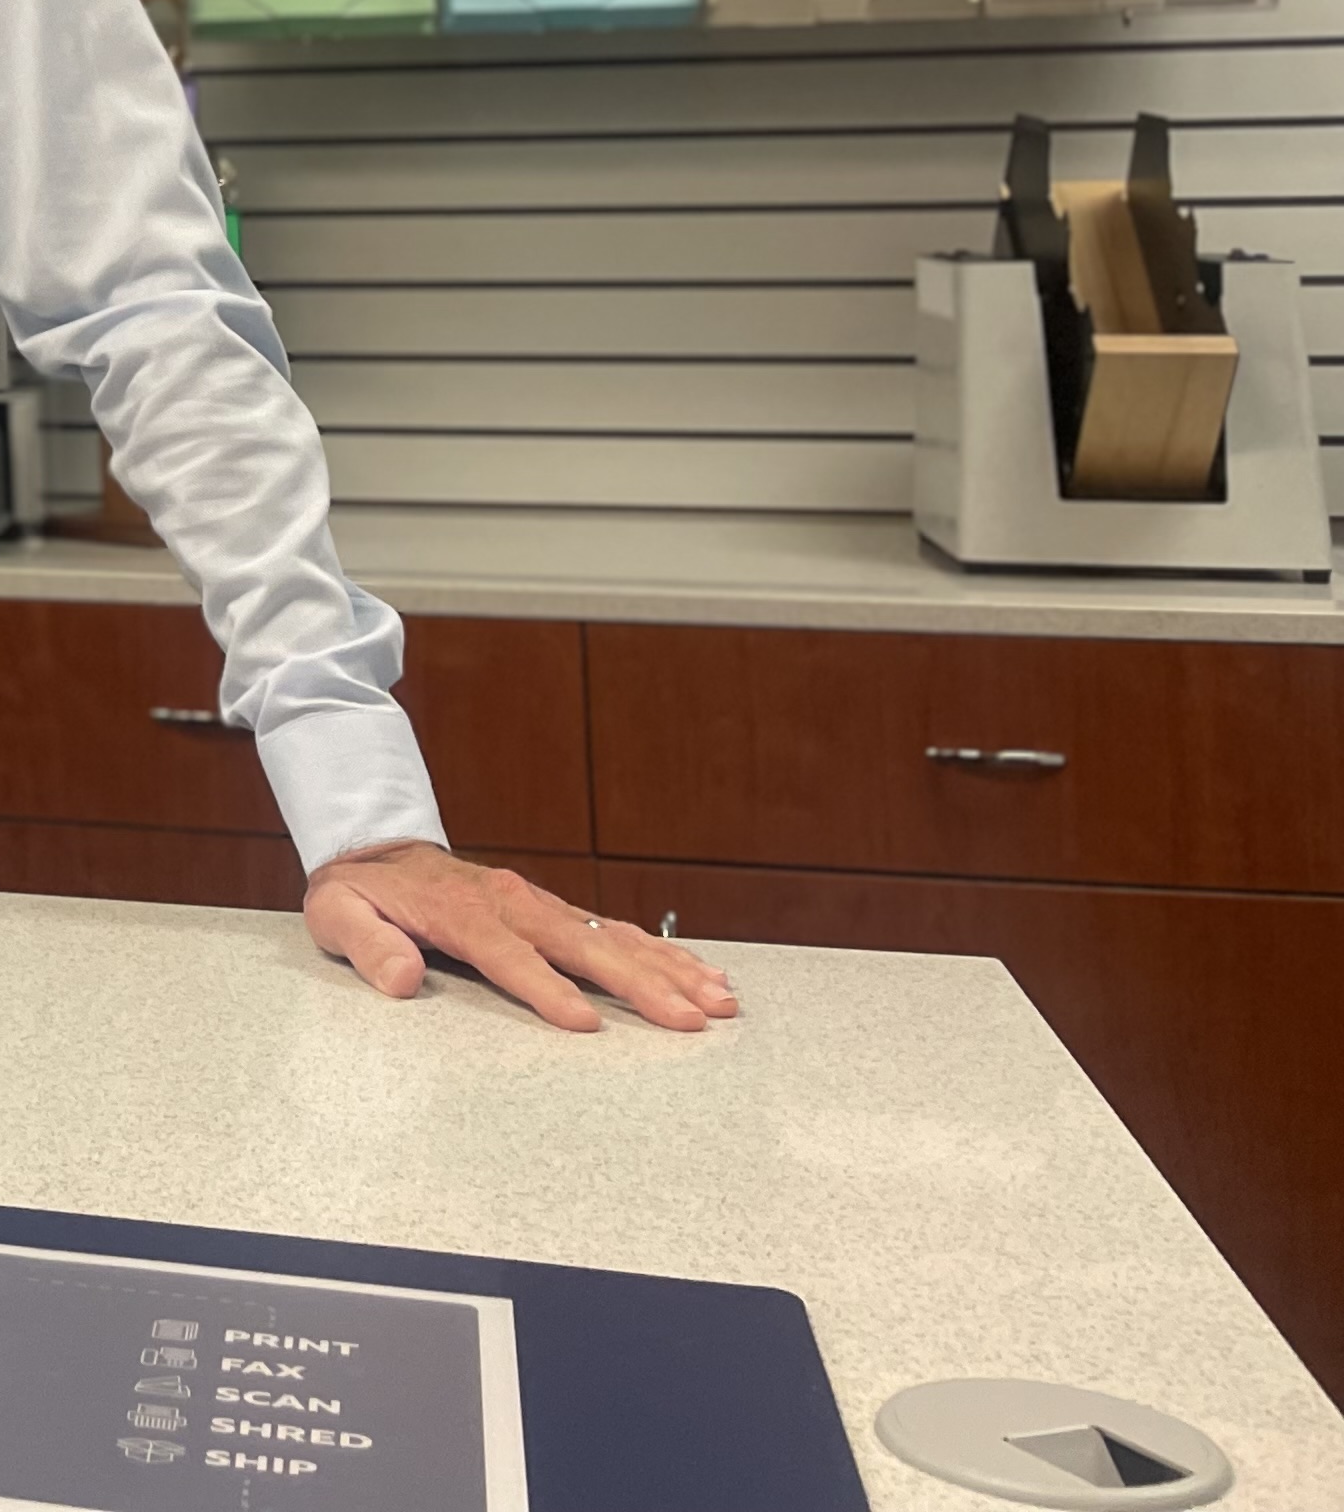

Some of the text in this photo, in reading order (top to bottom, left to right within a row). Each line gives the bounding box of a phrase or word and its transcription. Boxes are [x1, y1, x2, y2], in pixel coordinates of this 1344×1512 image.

[224, 1329, 359, 1356] PRINT
[221, 1357, 307, 1380] FAX
[215, 1386, 341, 1416] SCAN
[210, 1417, 373, 1449] SHRED
[204, 1449, 318, 1476] SHIP
